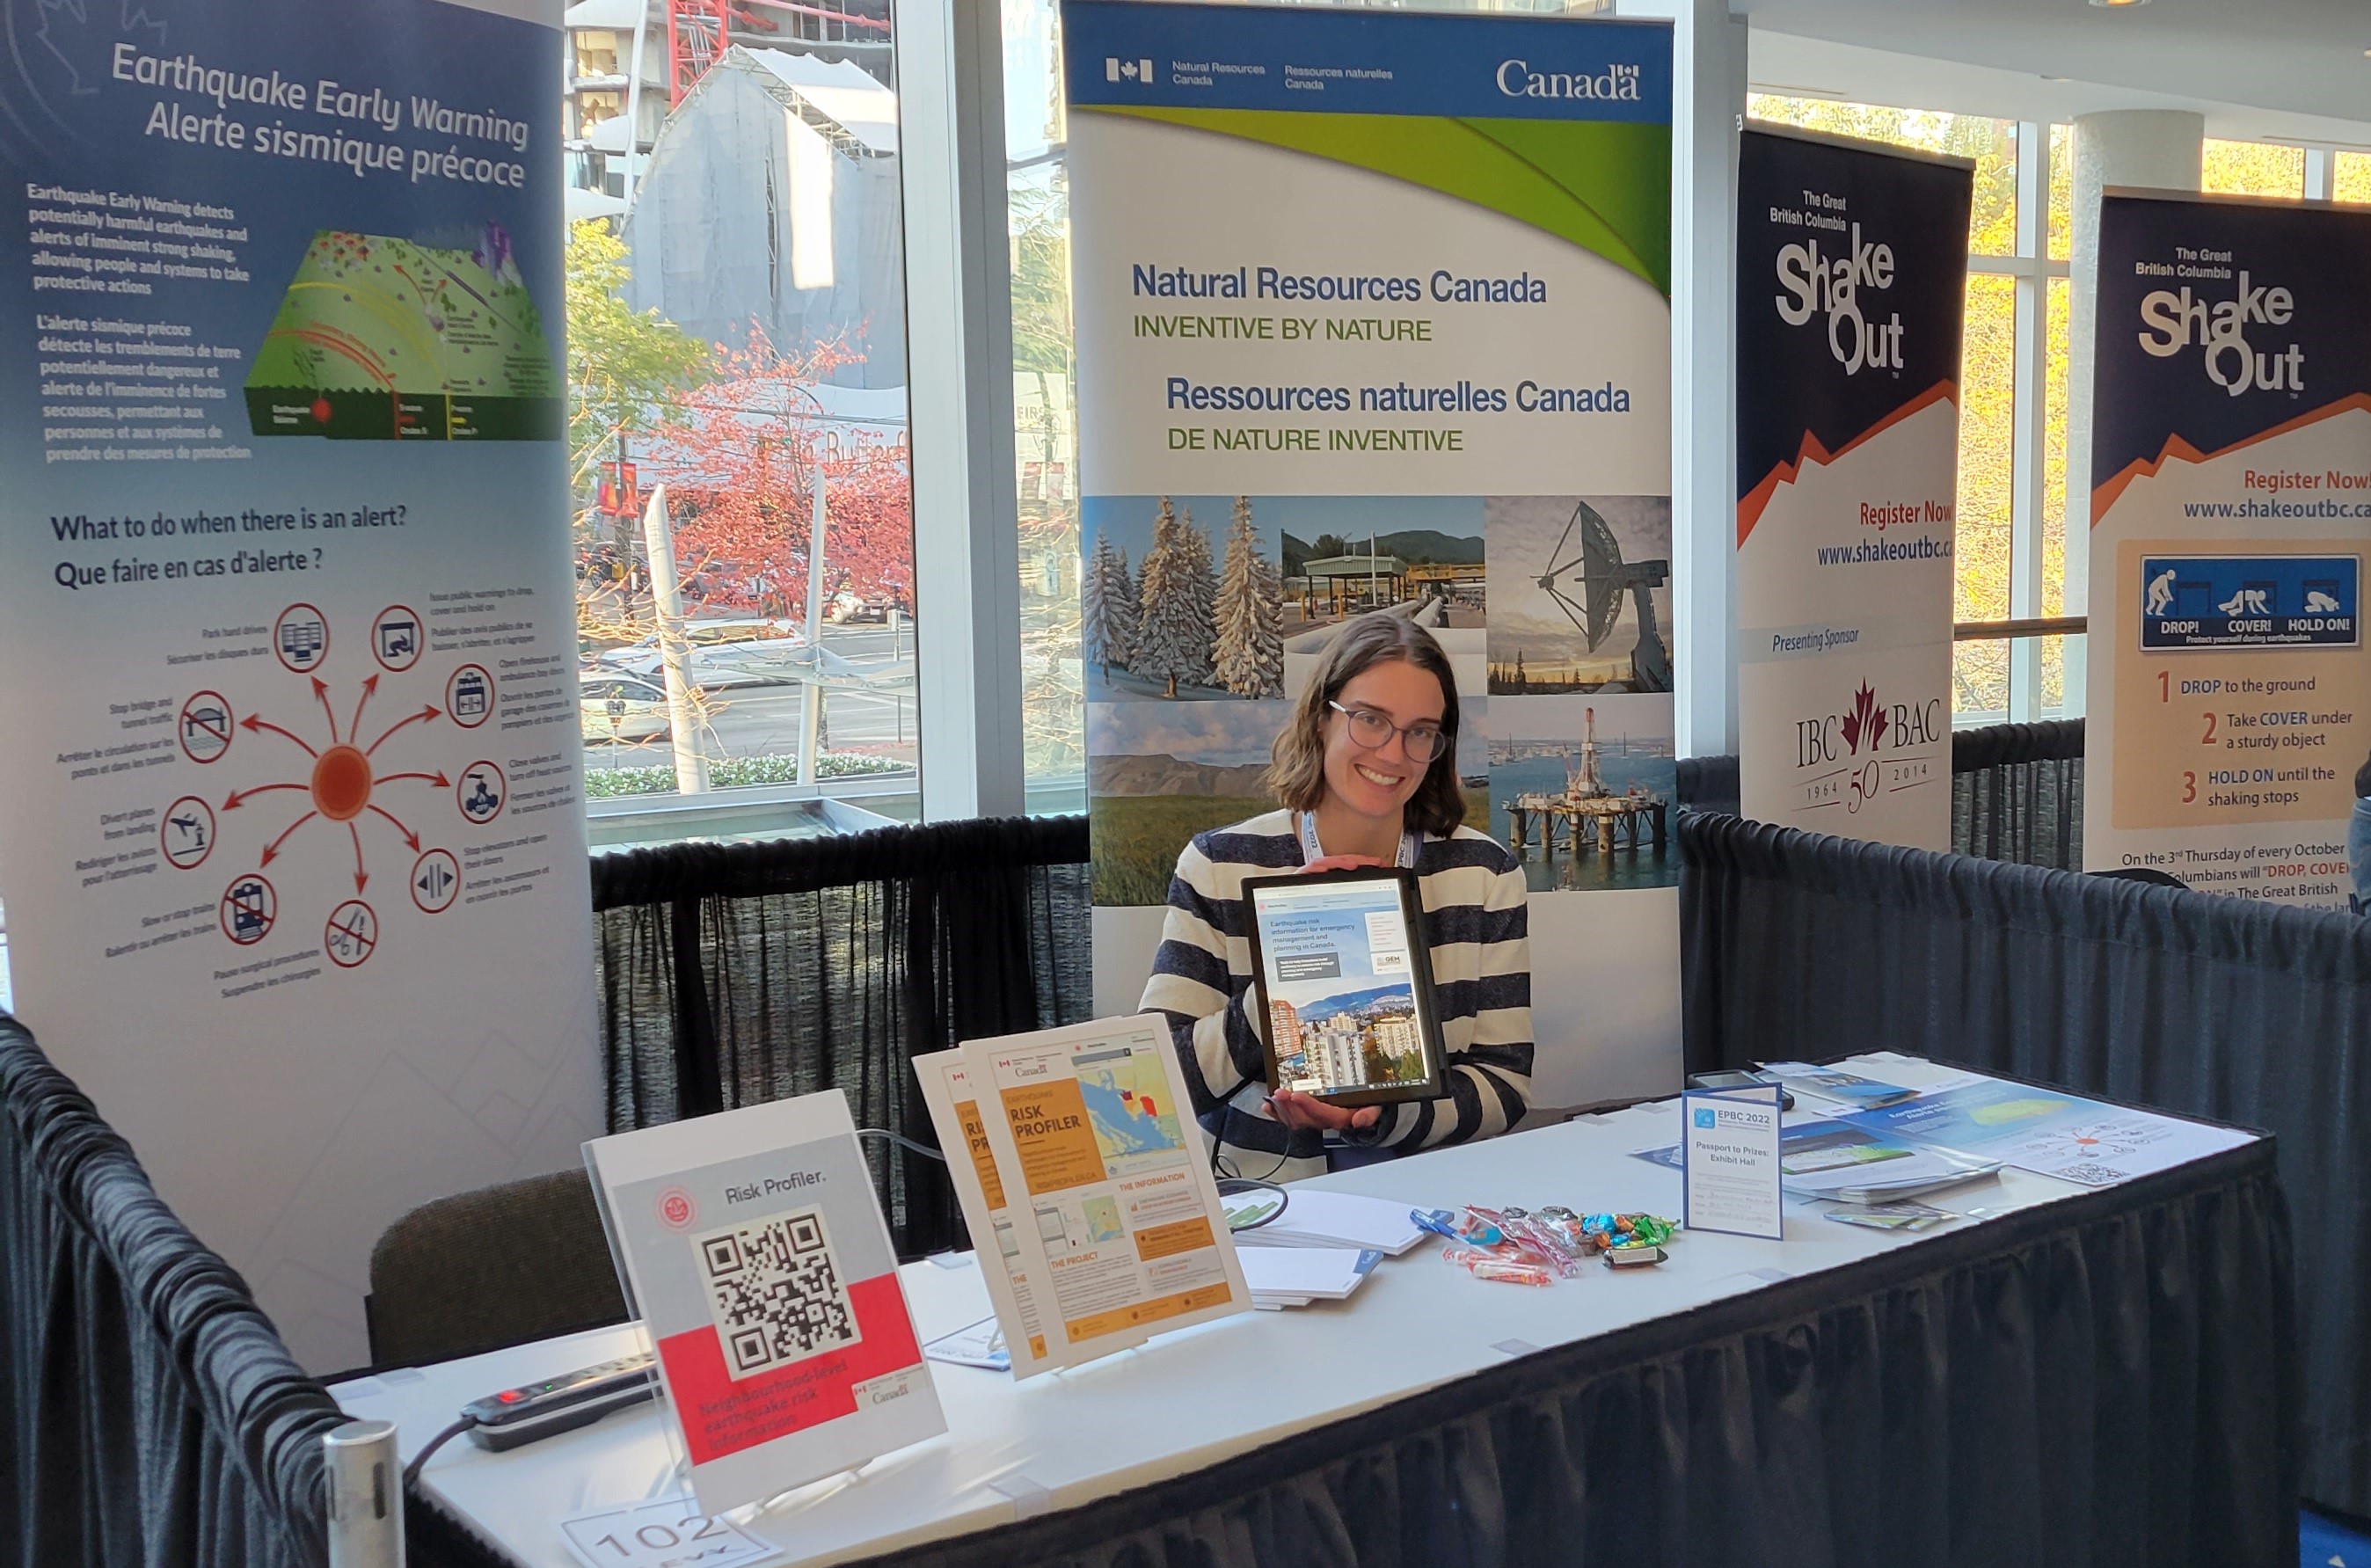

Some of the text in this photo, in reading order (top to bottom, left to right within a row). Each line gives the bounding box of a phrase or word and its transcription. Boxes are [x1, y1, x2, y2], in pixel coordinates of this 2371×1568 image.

[1172, 61, 1265, 74] Natural Resources
[1285, 65, 1393, 79] Ressources naturelles
[1497, 59, 1641, 100] Canada
[1172, 74, 1213, 86] Canada
[1285, 78, 1324, 90] Canada
[113, 42, 528, 151] Earthquake Early Warning
[145, 102, 525, 188] Alerte sismique précoce
[27, 183, 234, 220] Earthquake Early Warning detects
[1803, 190, 1846, 210] The Great
[29, 209, 247, 241] potentially harmful earthquakes and
[1770, 207, 1846, 231] British Columbia
[30, 229, 71, 245] alerts
[75, 232, 90, 246] of
[91, 234, 150, 252] imminent
[153, 241, 188, 259] strong
[2176, 247, 2232, 263] The Great
[1776, 222, 1894, 325] Shake
[2135, 263, 2231, 279] British Columbia
[1133, 265, 1547, 303] Natural Resources Canada
[2139, 271, 2294, 357] Shake
[1134, 315, 1433, 341] INVENTIVE BY NATURE
[1828, 303, 1904, 376] Out
[2205, 339, 2304, 397] Out
[1167, 377, 1631, 412] Ressources naturelles Canada
[1168, 428, 1463, 451] DE NATURE INVENTIVE
[2244, 470, 2371, 493] Register Now!
[1860, 501, 1921, 531] Register
[2184, 499, 2371, 518] www.shakeoutbc.ca
[50, 505, 405, 541] What to do when there is an alert?
[1818, 535, 1952, 565] www.shakeoutbc.ca
[55, 548, 322, 589] Que faire en cas d'alerte ?
[2161, 618, 2351, 634] DROP! COVER! HOLD ON!
[1772, 628, 1859, 652] Presenting Sponsor
[2214, 635, 2242, 644] yourself
[2267, 634, 2311, 643] earthquakes
[2158, 670, 2316, 703] 1 DROP to the ground
[1796, 699, 1940, 768] IBC BAC
[2201, 710, 2353, 744] 2 Take COVER under
[2226, 733, 2326, 750] a sturdy object
[1807, 759, 1927, 813] 1964 50 2014
[2182, 767, 2335, 804] 3 HOLD ON until the
[2208, 791, 2300, 807] shaking stops
[2122, 842, 2345, 866] On the 3rd Thursday of every October
[2240, 865, 2260, 879] will
[2238, 885, 2263, 899] The
[2264, 883, 2295, 897] Great
[2299, 882, 2338, 896] British
[1271, 919, 1307, 928] Earthquake
[1271, 925, 1308, 935] information
[1319, 923, 1354, 932] emergency
[1015, 1065, 1047, 1077] Canada
[1010, 1105, 1044, 1122] RISK
[1718, 1110, 1769, 1124] EPBC 2022
[1015, 1114, 1082, 1139] PROFILER
[1696, 1141, 1731, 1152] Passport
[1743, 1147, 1769, 1156] Prizes:
[1711, 1154, 1755, 1166] Exhibit Hall
[725, 1169, 828, 1205] Risk Profiler.
[1120, 1172, 1186, 1192] THE INFORMATION
[1051, 1251, 1099, 1270] THE PROJECT
[872, 1383, 909, 1405] Canada
[704, 1387, 818, 1434] earthquake risk
[708, 1414, 797, 1451] information
[595, 1515, 729, 1557] 102
